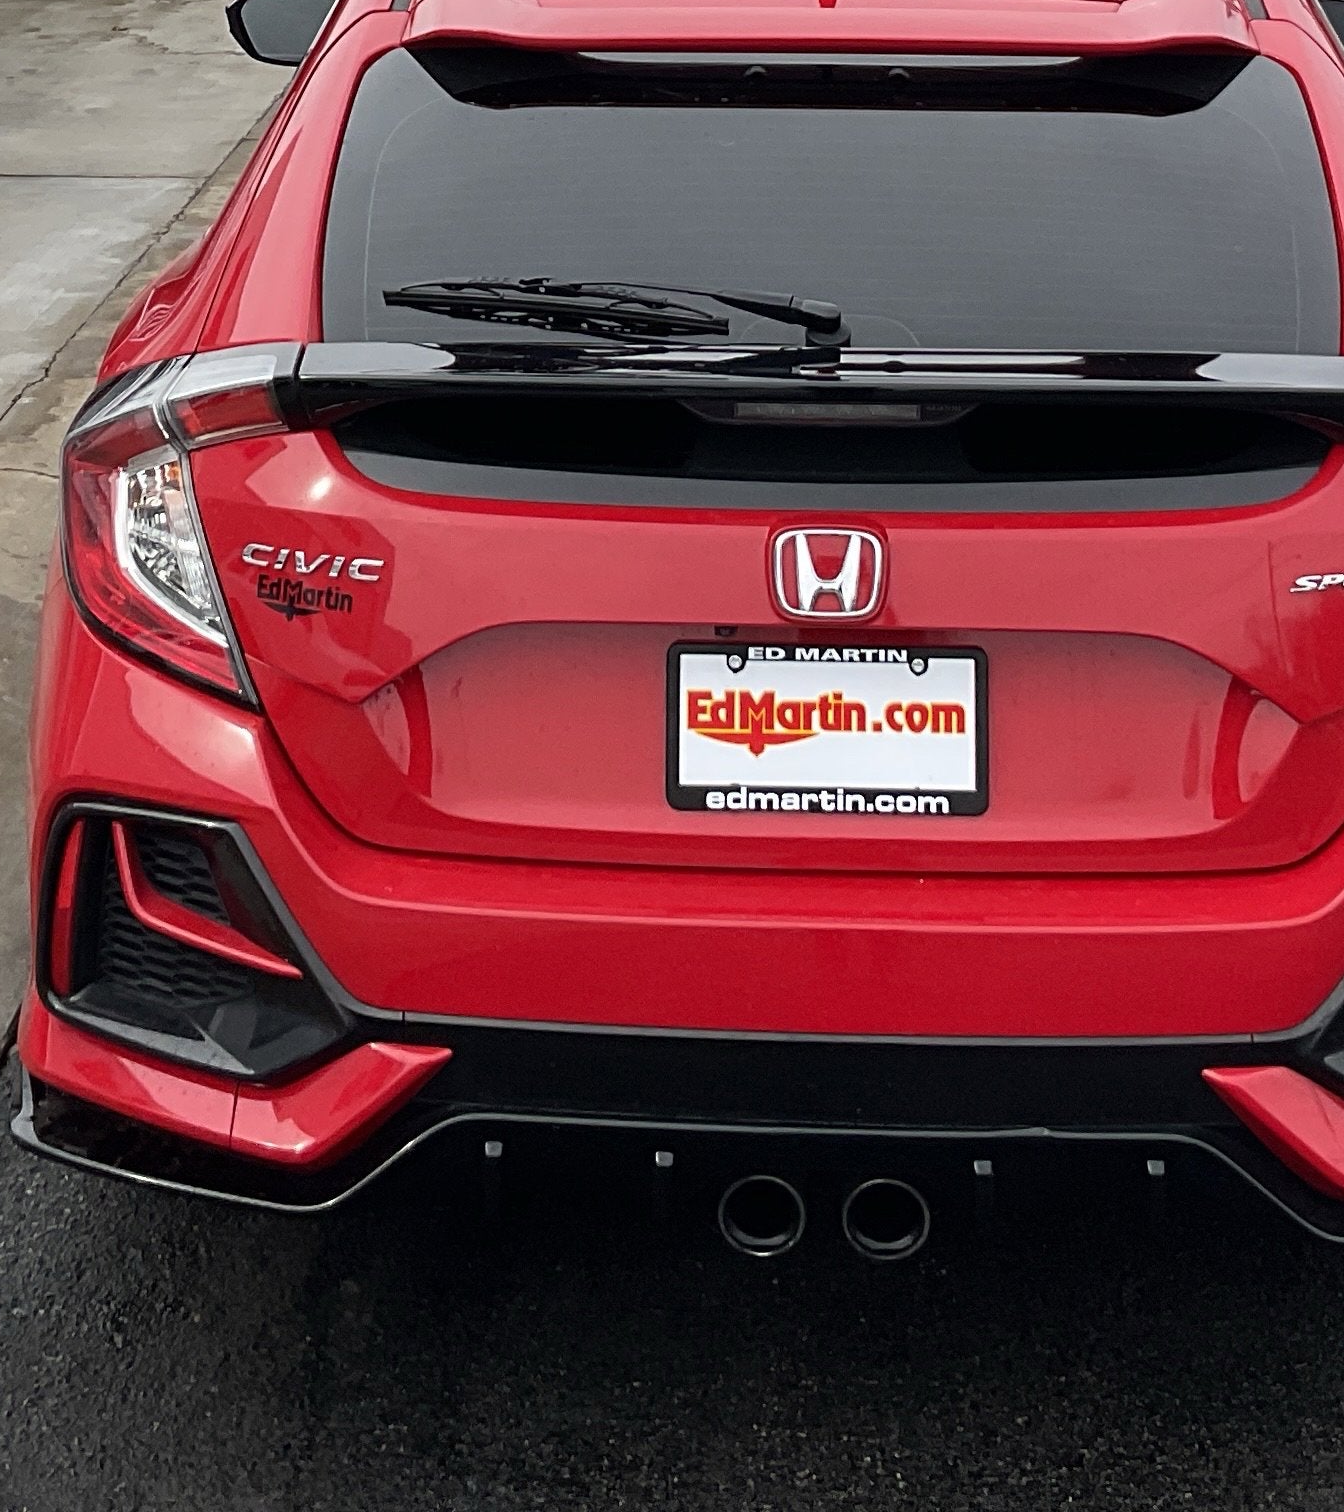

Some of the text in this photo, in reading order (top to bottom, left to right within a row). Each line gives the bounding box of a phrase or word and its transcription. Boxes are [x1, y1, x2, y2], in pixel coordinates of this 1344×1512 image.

[241, 542, 385, 582] CIVIC
[748, 646, 908, 662] ED MARTIN
[706, 787, 950, 814] edmartin.com
